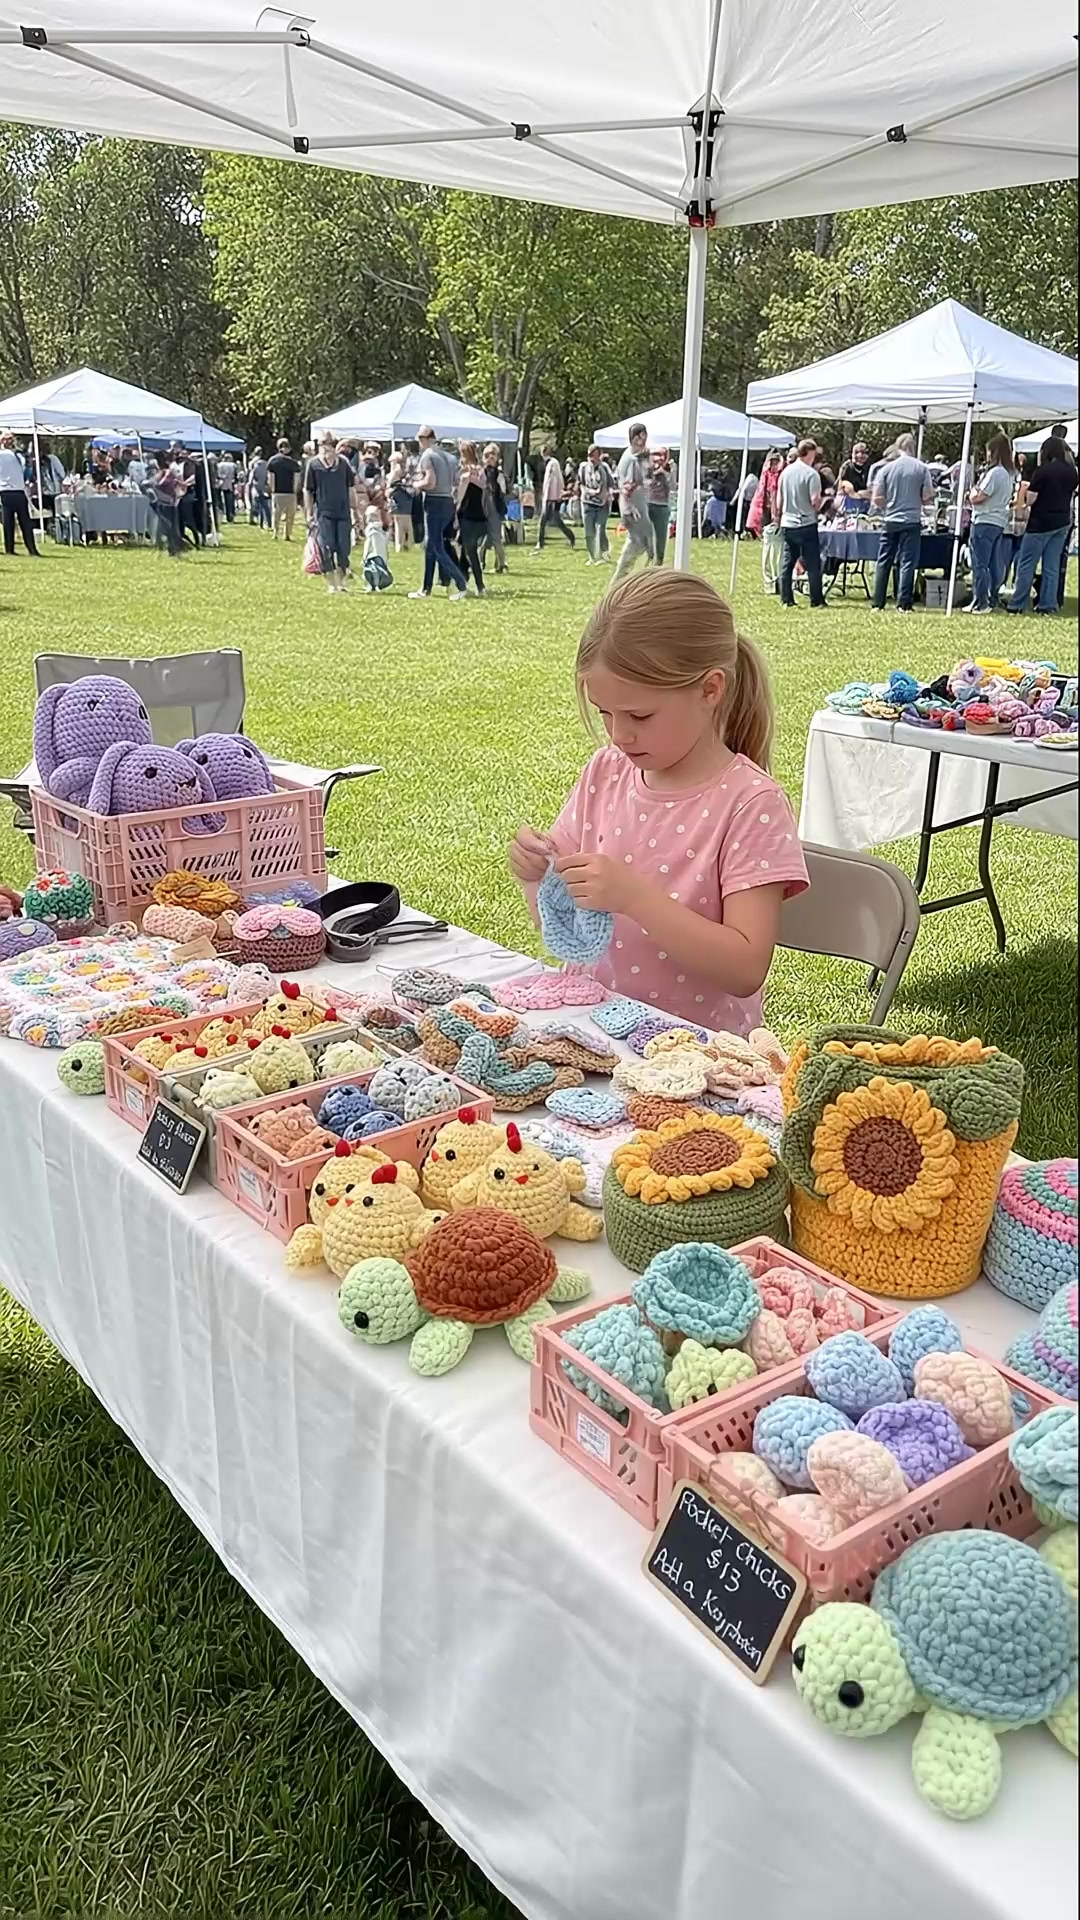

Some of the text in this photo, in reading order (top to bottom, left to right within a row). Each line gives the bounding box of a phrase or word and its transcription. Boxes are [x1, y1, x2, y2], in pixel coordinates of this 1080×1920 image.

[679, 1491, 792, 1600] Pocket Chicks
[706, 1548, 742, 1593] $13
[653, 1548, 684, 1585] Add
[683, 1580, 695, 1599] a
